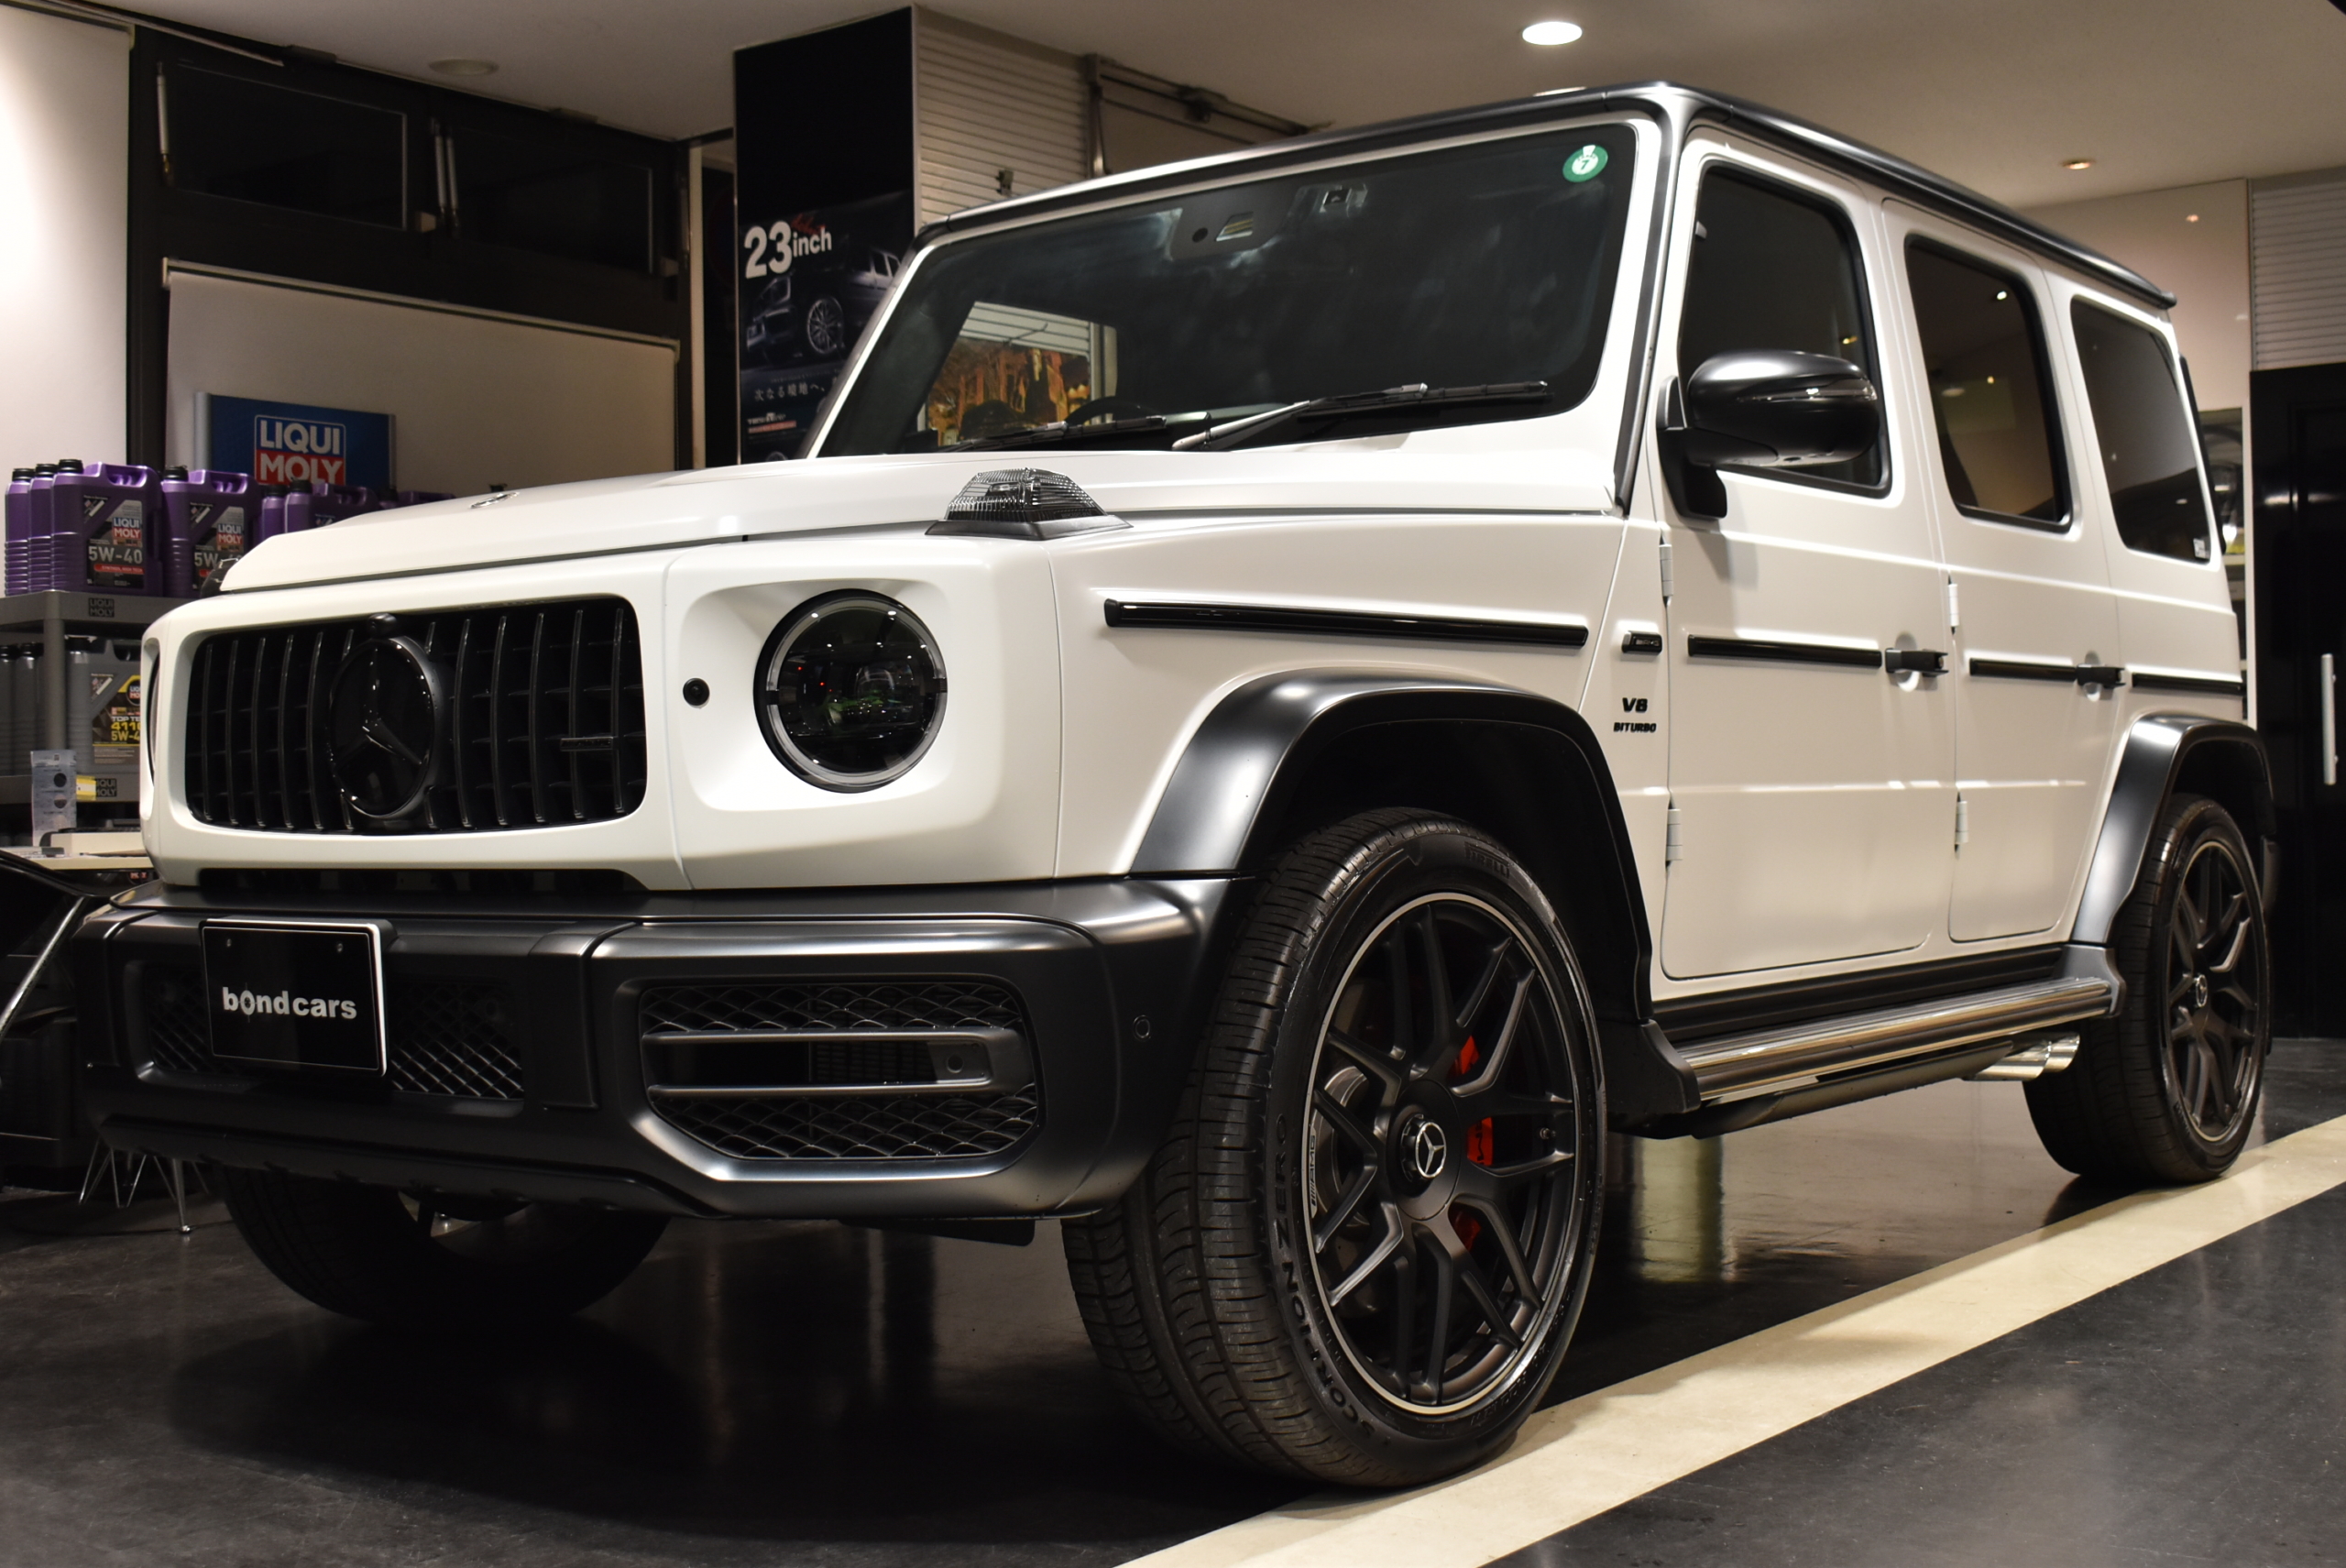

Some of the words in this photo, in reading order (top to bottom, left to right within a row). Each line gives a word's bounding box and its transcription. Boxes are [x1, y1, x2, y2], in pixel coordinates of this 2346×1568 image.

[1581, 159, 1590, 170] 7
[260, 420, 340, 455] LIQUI
[260, 453, 343, 485] MOLY
[113, 518, 140, 529] LIQUI
[217, 524, 242, 534] LIQUI
[114, 528, 141, 539] MOLY
[218, 534, 243, 544] MOLY
[88, 546, 143, 565] 5W-40
[90, 598, 114, 608] LIQUI
[90, 608, 115, 617] MOLY
[1622, 697, 1648, 713] V8
[1614, 722, 1657, 733] BITURBO
[111, 730, 140, 741] 5W-4
[96, 779, 115, 788] IQUI
[96, 788, 116, 796] OLY
[1275, 1113, 1293, 1250] ZERO
[1282, 1261, 1376, 1439] SCORPION
